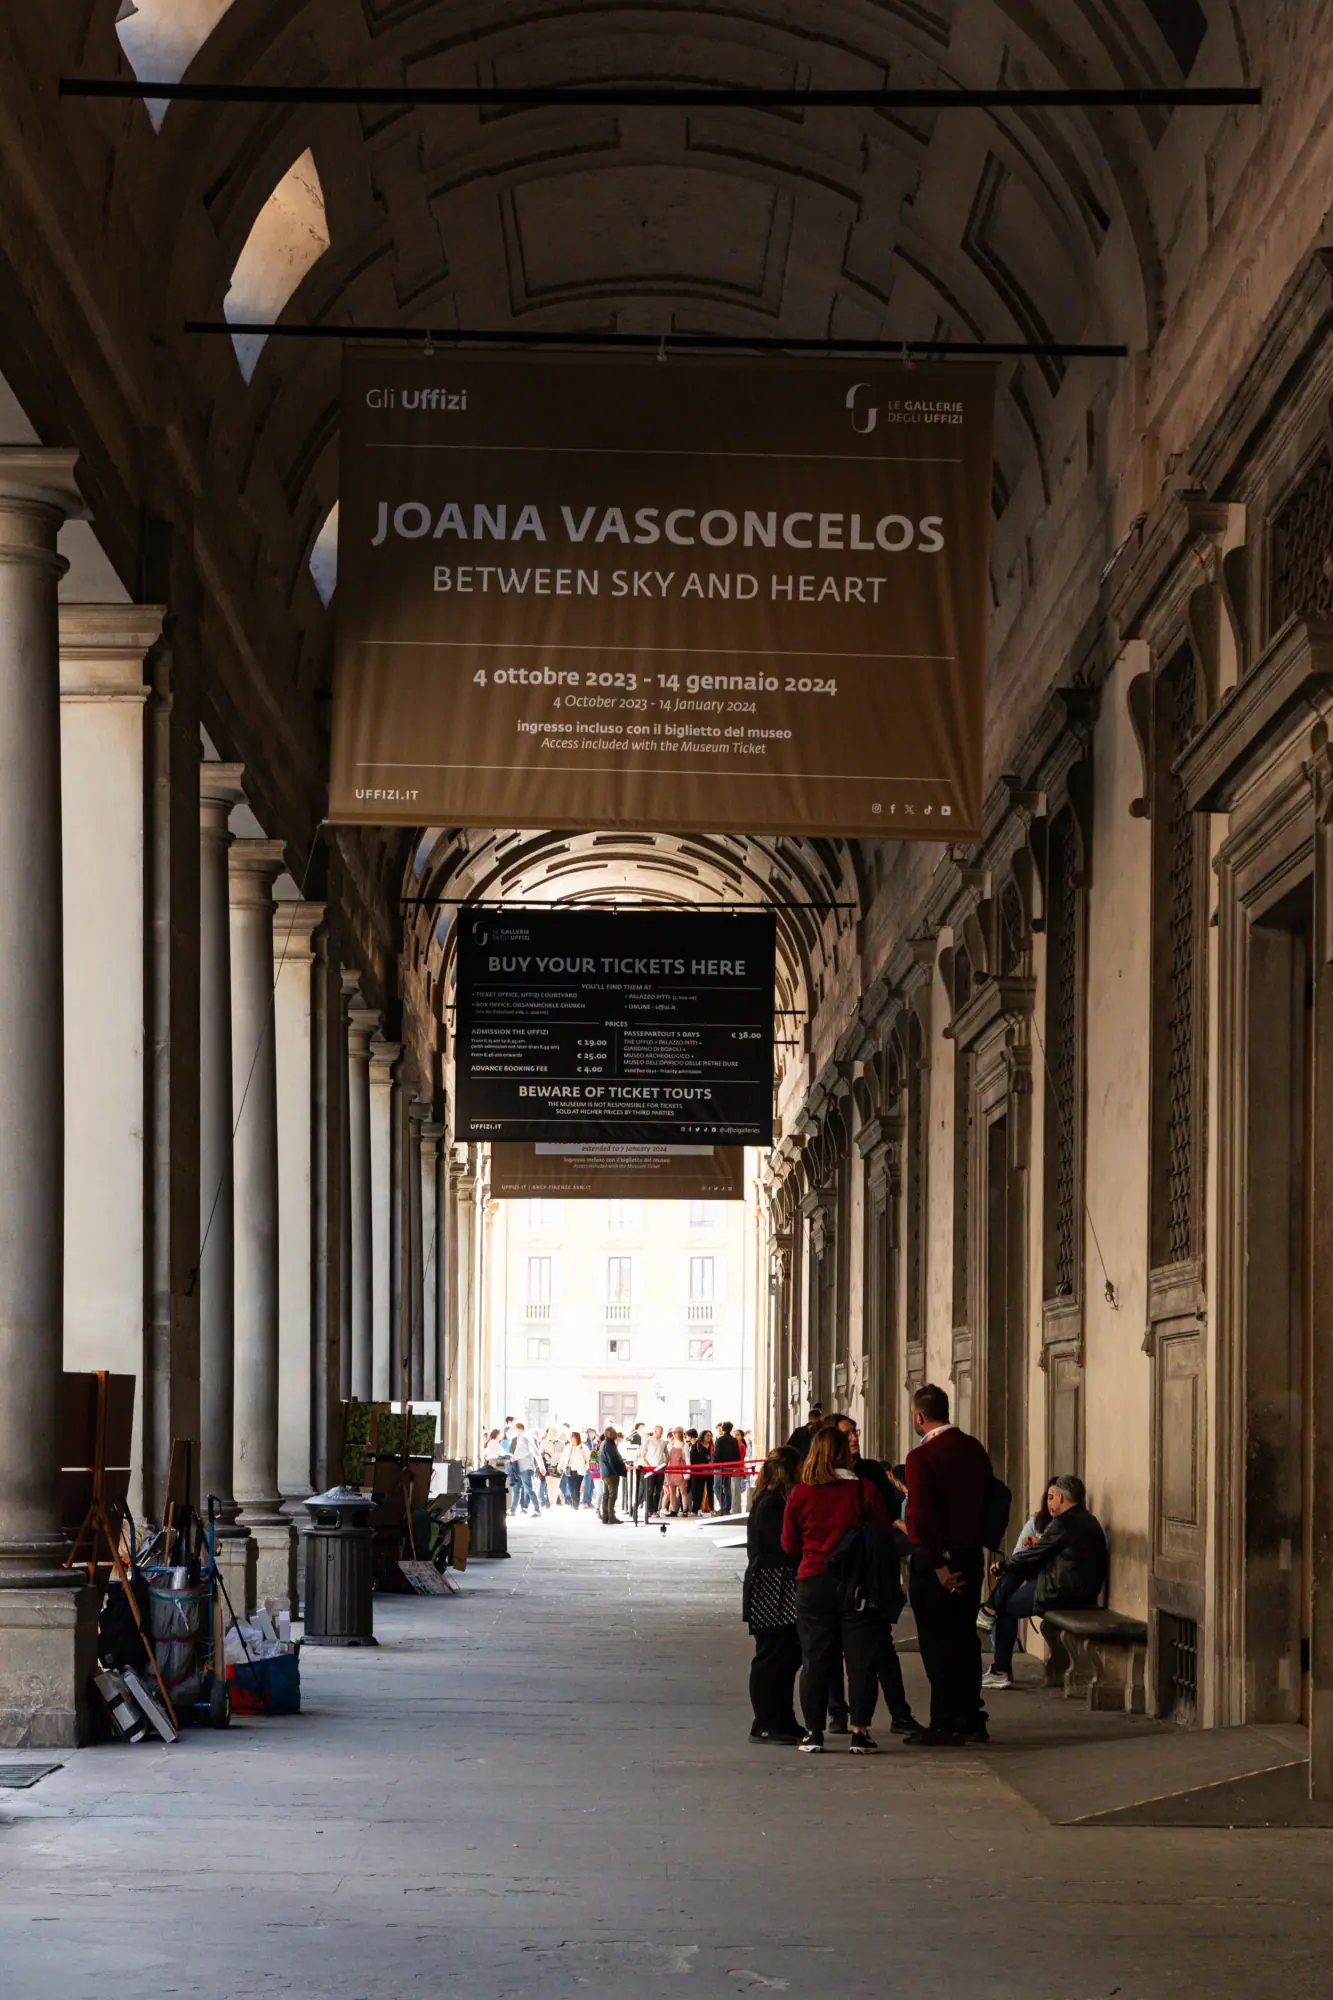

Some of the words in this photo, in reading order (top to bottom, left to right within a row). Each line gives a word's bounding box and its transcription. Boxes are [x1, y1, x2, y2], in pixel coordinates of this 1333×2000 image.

[366, 389, 395, 409] Gli
[402, 389, 467, 411] Uffizi
[889, 401, 900, 410] LE
[904, 402, 963, 412] GALLERIE
[889, 413, 920, 422] DEGLI
[925, 414, 962, 423] UFFIZI
[370, 502, 547, 547] JOANA
[561, 506, 944, 552] VASCONCELOS
[434, 566, 598, 595] BETWEEN
[612, 571, 676, 598] SKY
[682, 574, 758, 599] AND
[772, 576, 886, 603] HEART
[473, 669, 486, 688] 4
[494, 667, 579, 685] ottobre
[586, 672, 637, 689] 2023
[657, 674, 679, 691] 14
[687, 672, 779, 694] gennaio
[785, 677, 837, 696] 2024
[554, 698, 560, 709] 4
[564, 696, 616, 709] October
[619, 698, 647, 711] 2023
[659, 699, 671, 711] 14
[674, 699, 724, 715] January
[727, 701, 756, 714] 2024
[517, 720, 572, 736] ingresso
[576, 720, 623, 734] incluso
[627, 725, 650, 735] con
[654, 723, 661, 735] il
[665, 723, 721, 740] biglietto
[724, 725, 744, 737] del
[748, 728, 791, 739] museo
[542, 737, 578, 749] Access
[581, 738, 628, 751] included
[631, 738, 656, 751] with
[661, 740, 678, 752] the
[681, 741, 729, 753] Museum
[733, 742, 766, 754] Ticket
[355, 789, 418, 801] UFFIZI.IT
[489, 957, 532, 972] BUY
[535, 957, 595, 973] YOUR
[601, 958, 685, 975] TICKETS
[692, 960, 745, 975] HERE
[519, 1086, 580, 1097] BEWARE
[584, 1087, 605, 1098] OF
[608, 1087, 660, 1098] TICKET
[664, 1088, 712, 1099] TOUTS
